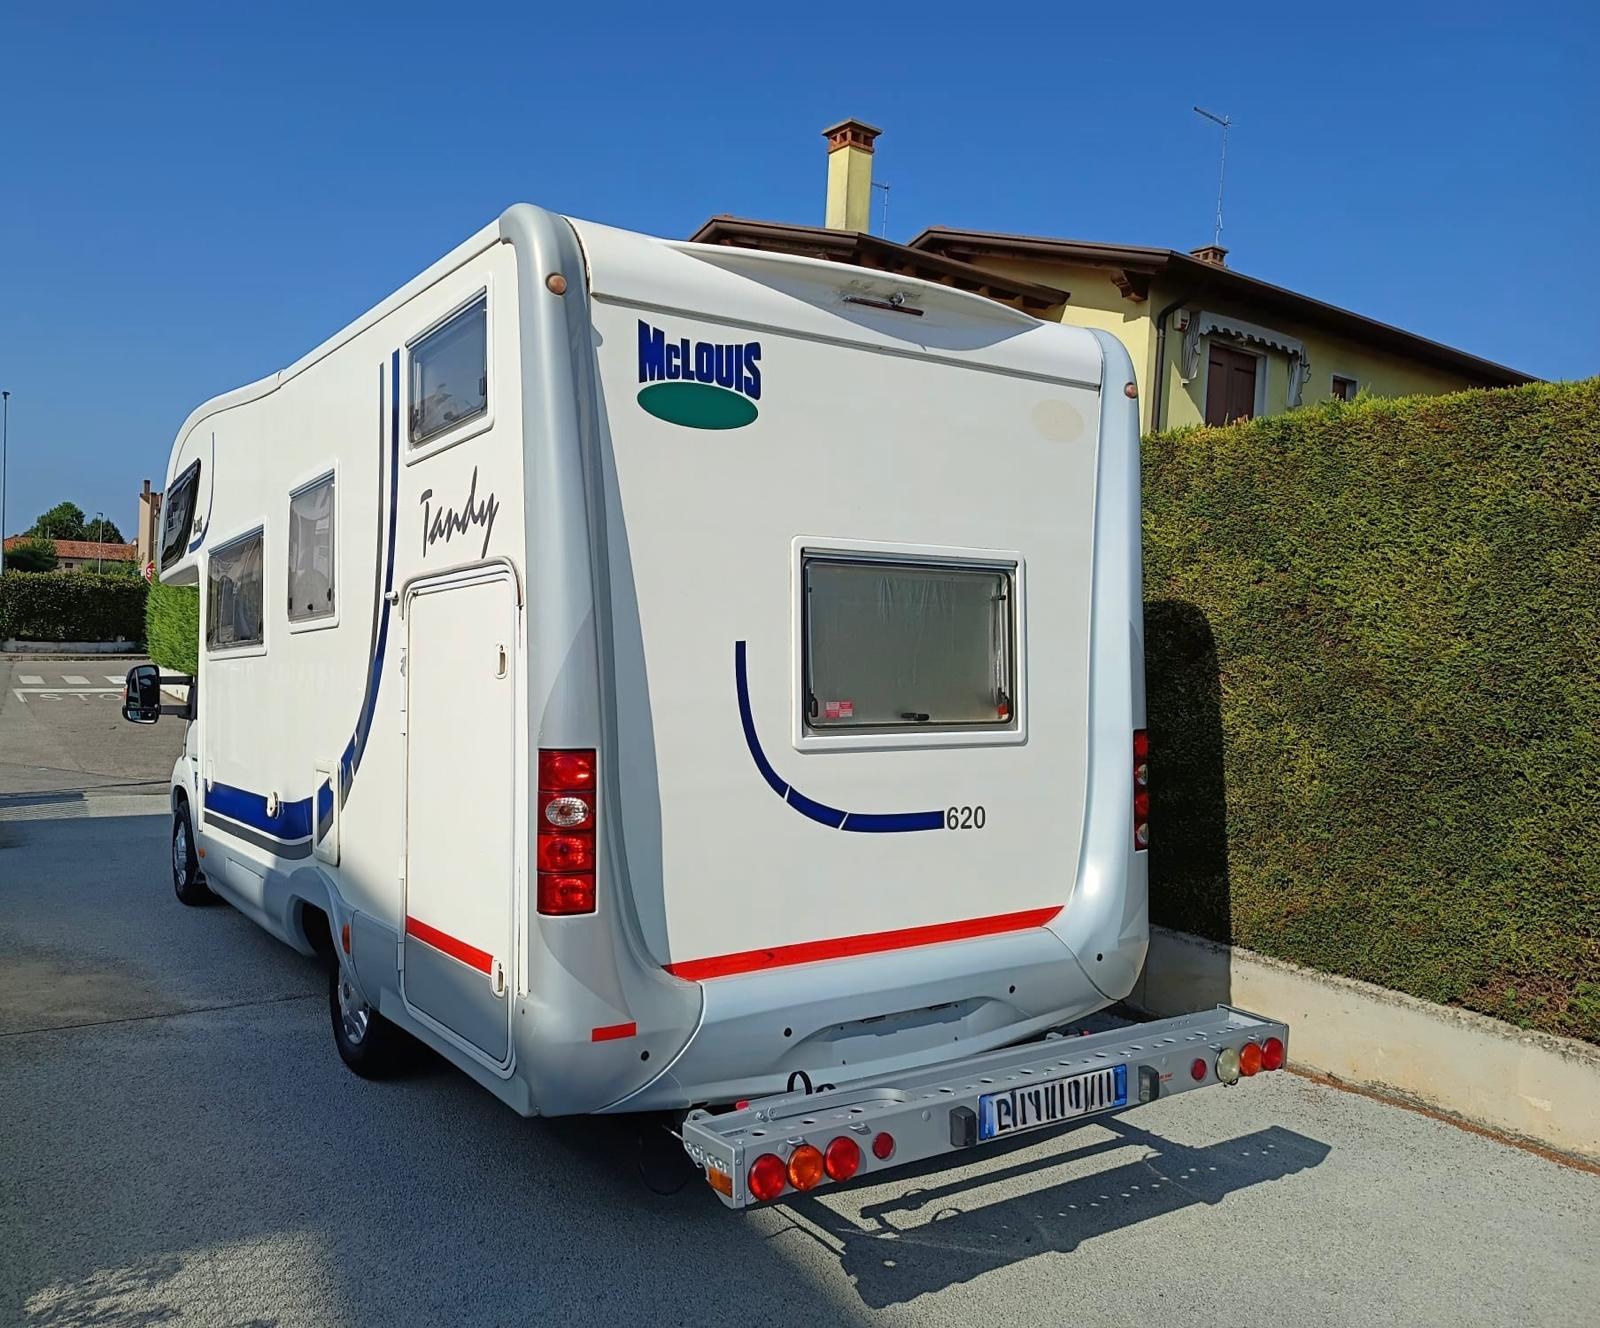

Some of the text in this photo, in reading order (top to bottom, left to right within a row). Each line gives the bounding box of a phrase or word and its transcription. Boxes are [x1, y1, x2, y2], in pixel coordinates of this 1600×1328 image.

[420, 465, 500, 559] Tandy
[39, 693, 126, 701] STO
[946, 806, 986, 830] 620
